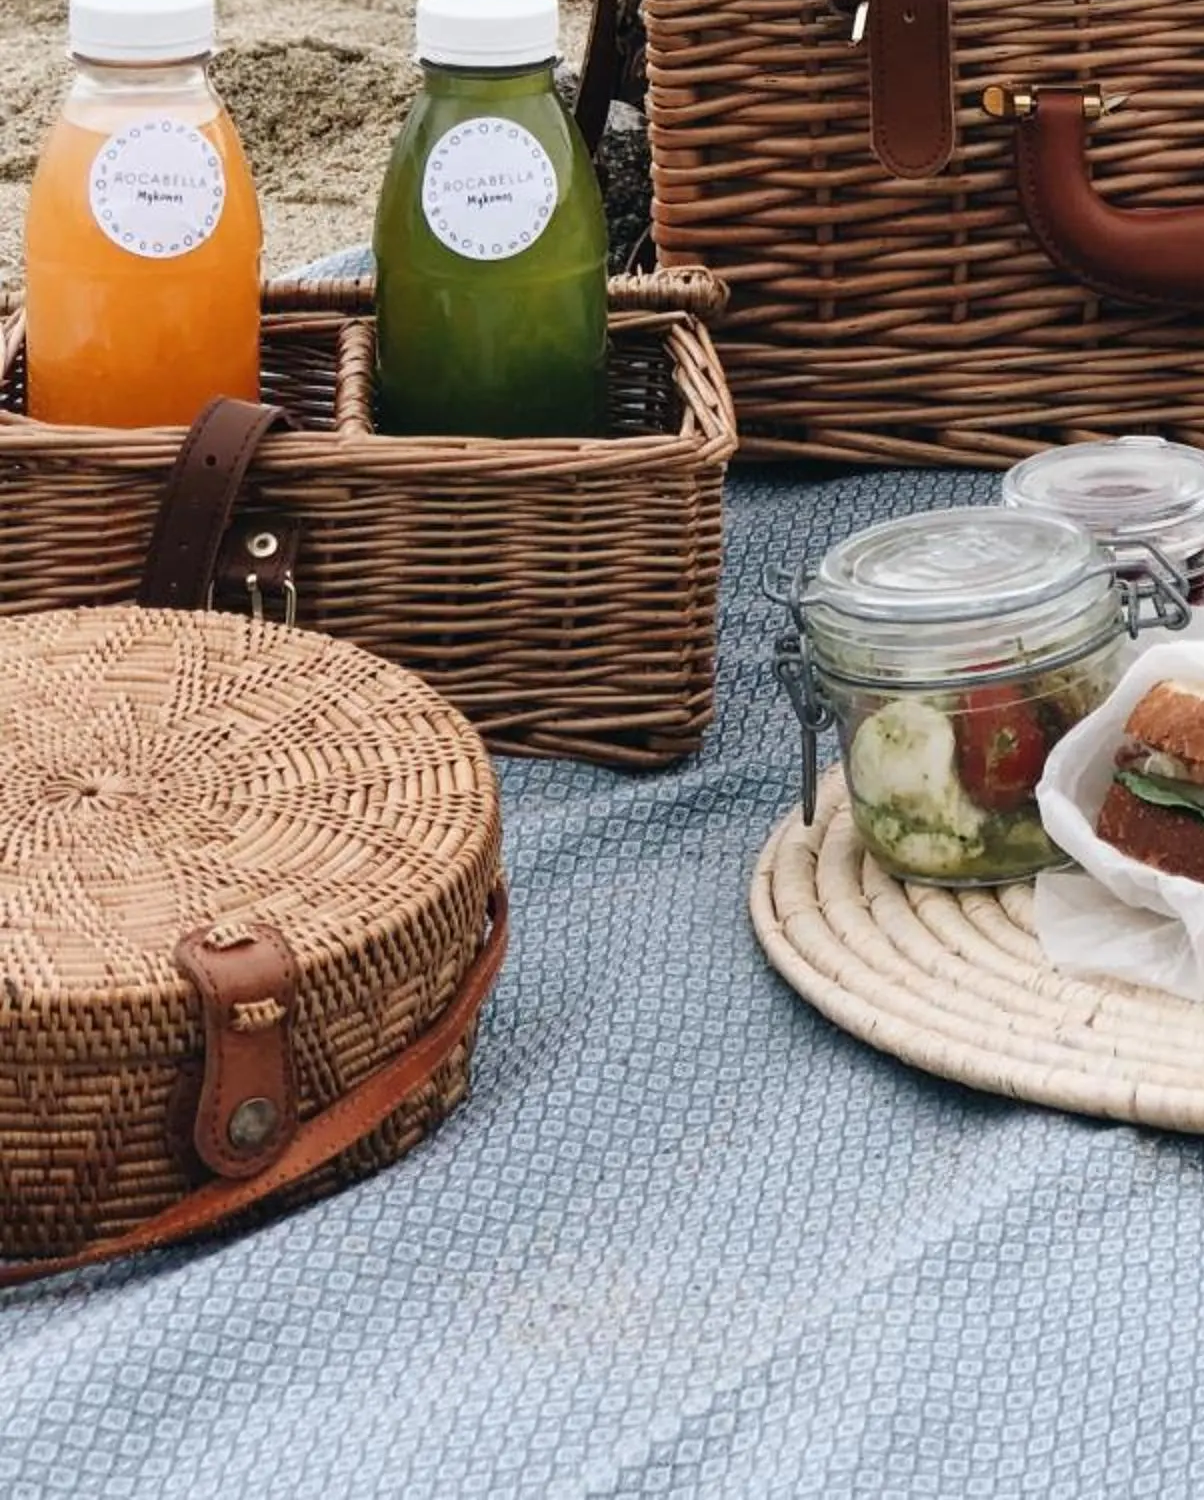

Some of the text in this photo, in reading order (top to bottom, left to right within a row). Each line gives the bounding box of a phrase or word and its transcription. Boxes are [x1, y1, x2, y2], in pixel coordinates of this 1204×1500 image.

[114, 171, 207, 188] ROCABELLA
[443, 171, 533, 191] ROCABELLA
[138, 190, 183, 205] Mykonos
[467, 192, 512, 208] Mykonos
